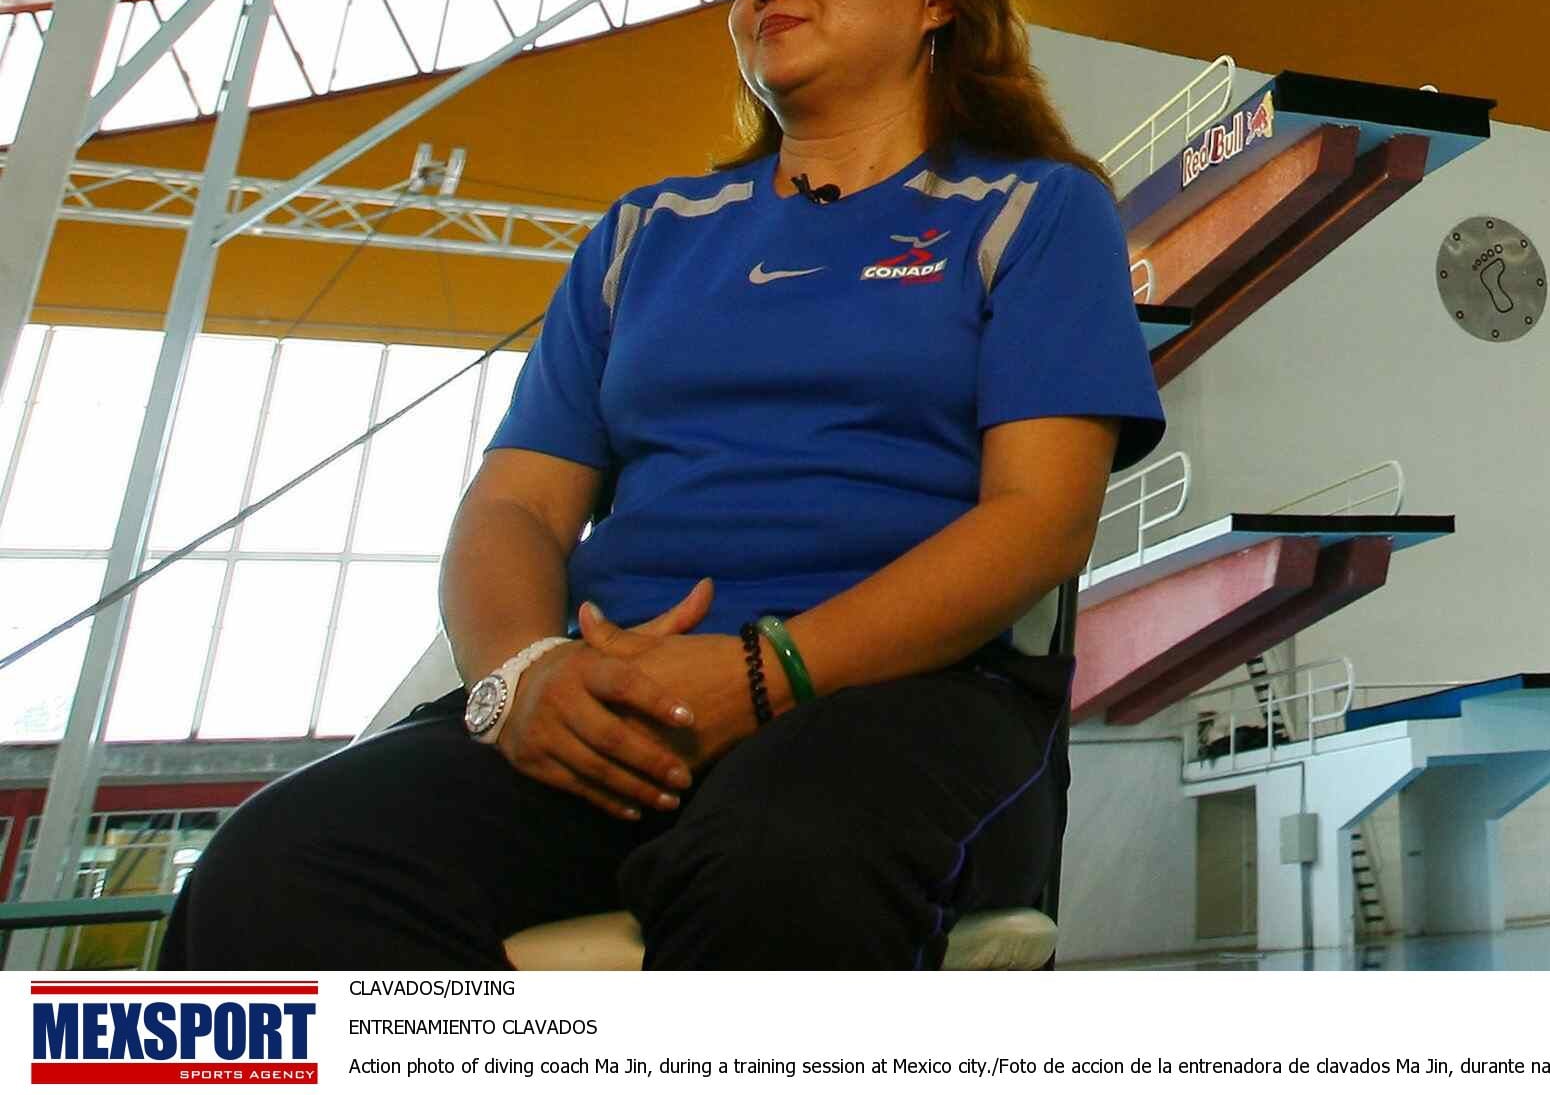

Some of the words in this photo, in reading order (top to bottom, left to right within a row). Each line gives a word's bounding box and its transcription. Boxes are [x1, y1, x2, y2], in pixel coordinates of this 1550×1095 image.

[1182, 129, 1210, 187] Red
[1210, 111, 1244, 164] Bull
[863, 258, 948, 279] CONADE
